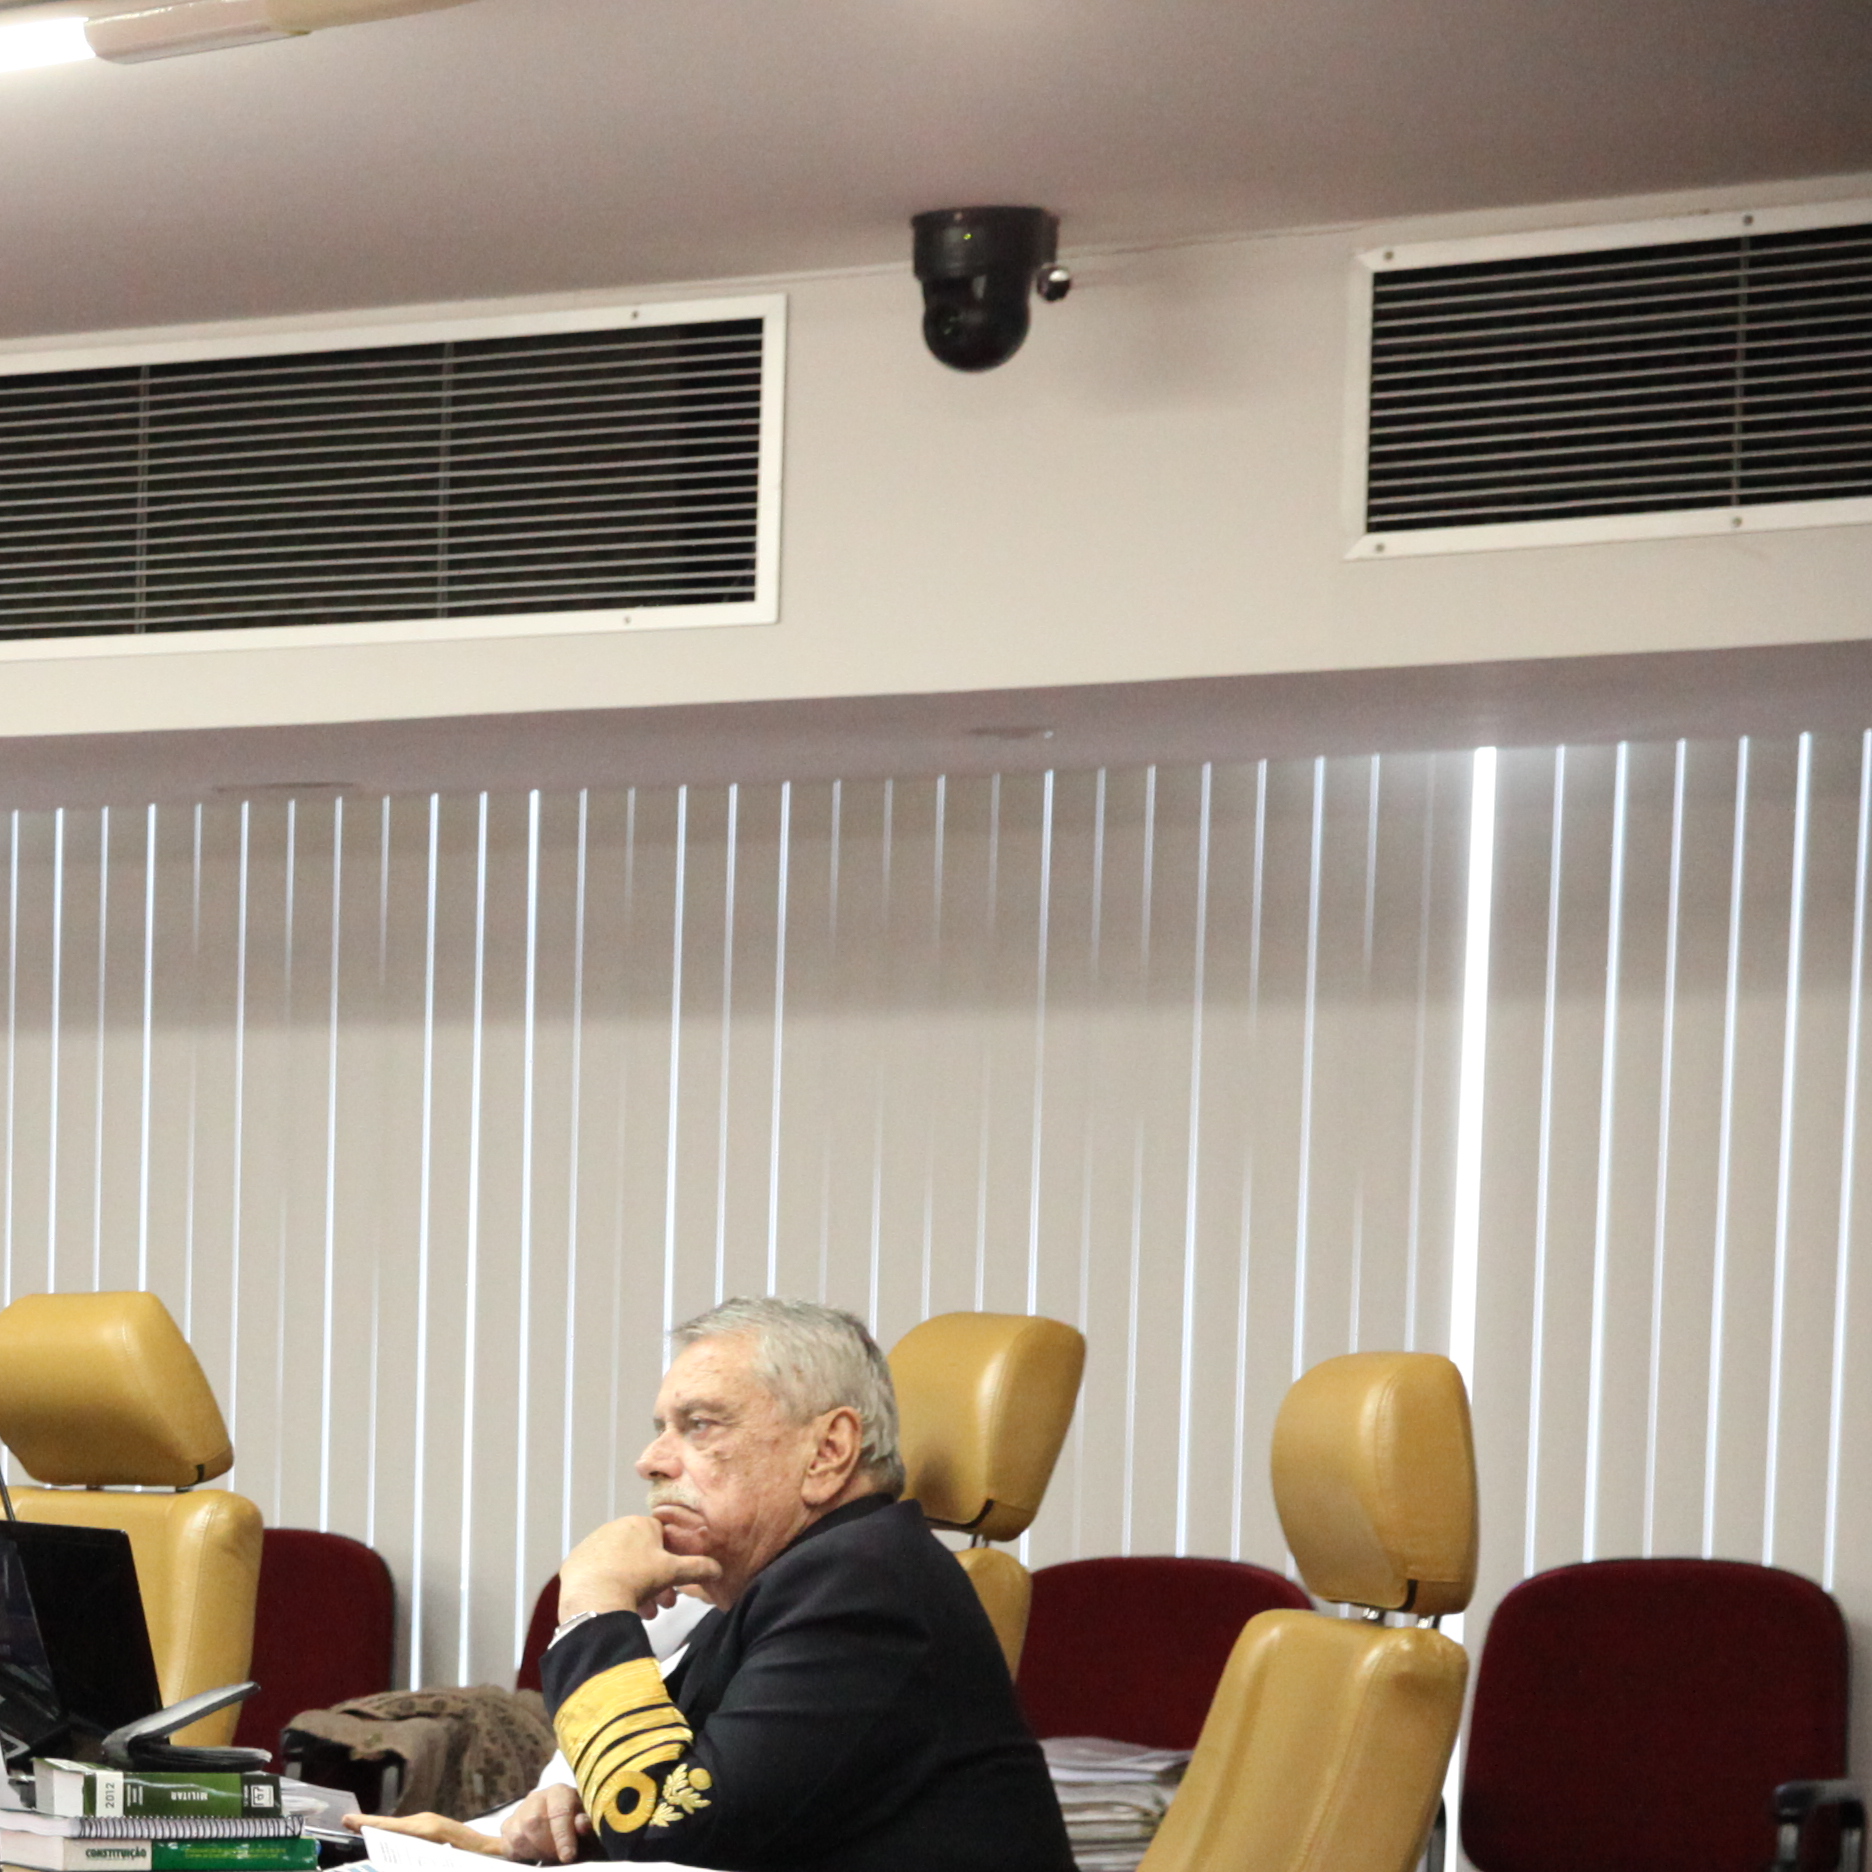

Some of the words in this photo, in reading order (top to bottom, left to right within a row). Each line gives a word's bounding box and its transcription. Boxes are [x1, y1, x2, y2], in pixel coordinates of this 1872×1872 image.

[105, 1782, 115, 1809] 2012
[170, 1791, 208, 1801] MILITAR
[85, 1846, 147, 1861] CONSTITUIÇÃO
